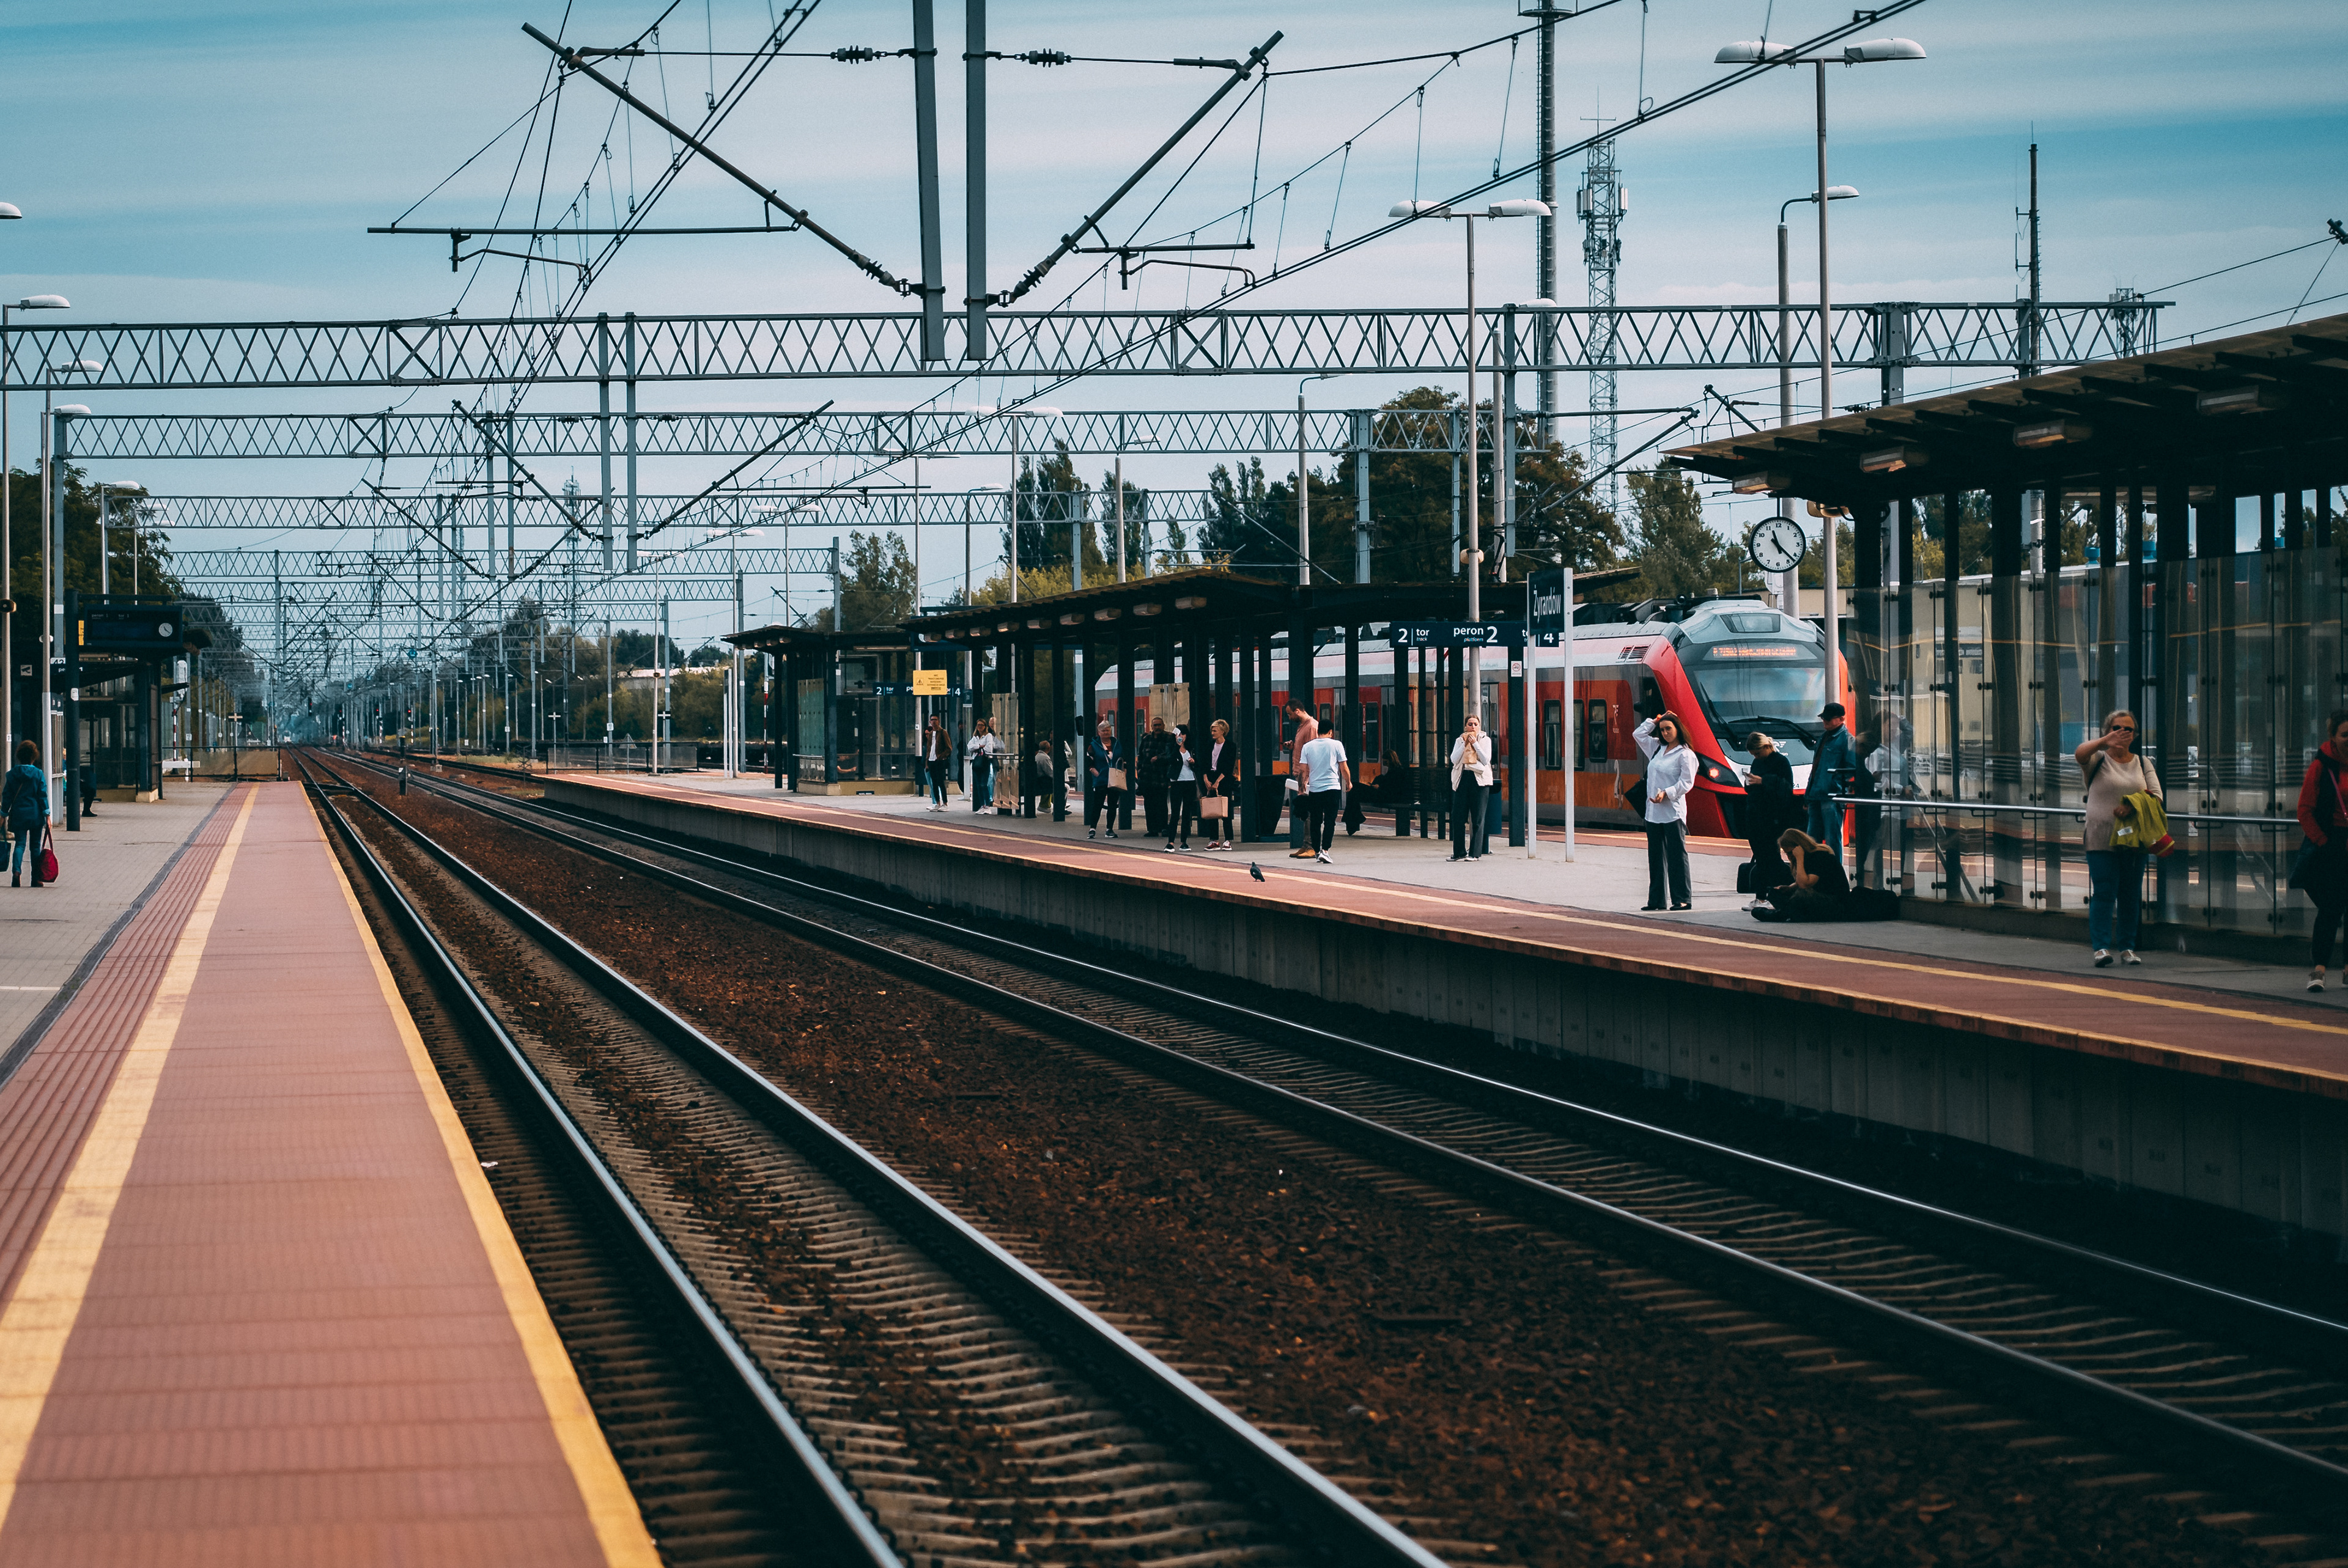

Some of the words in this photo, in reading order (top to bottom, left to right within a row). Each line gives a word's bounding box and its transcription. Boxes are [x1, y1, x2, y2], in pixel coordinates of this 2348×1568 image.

[1533, 584, 1561, 624] Żyrardów
[1398, 628, 1408, 642] 2
[1453, 627, 1483, 637] peron
[1486, 626, 1497, 642] 2
[1543, 633, 1554, 643] 4
[876, 686, 882, 695] 2
